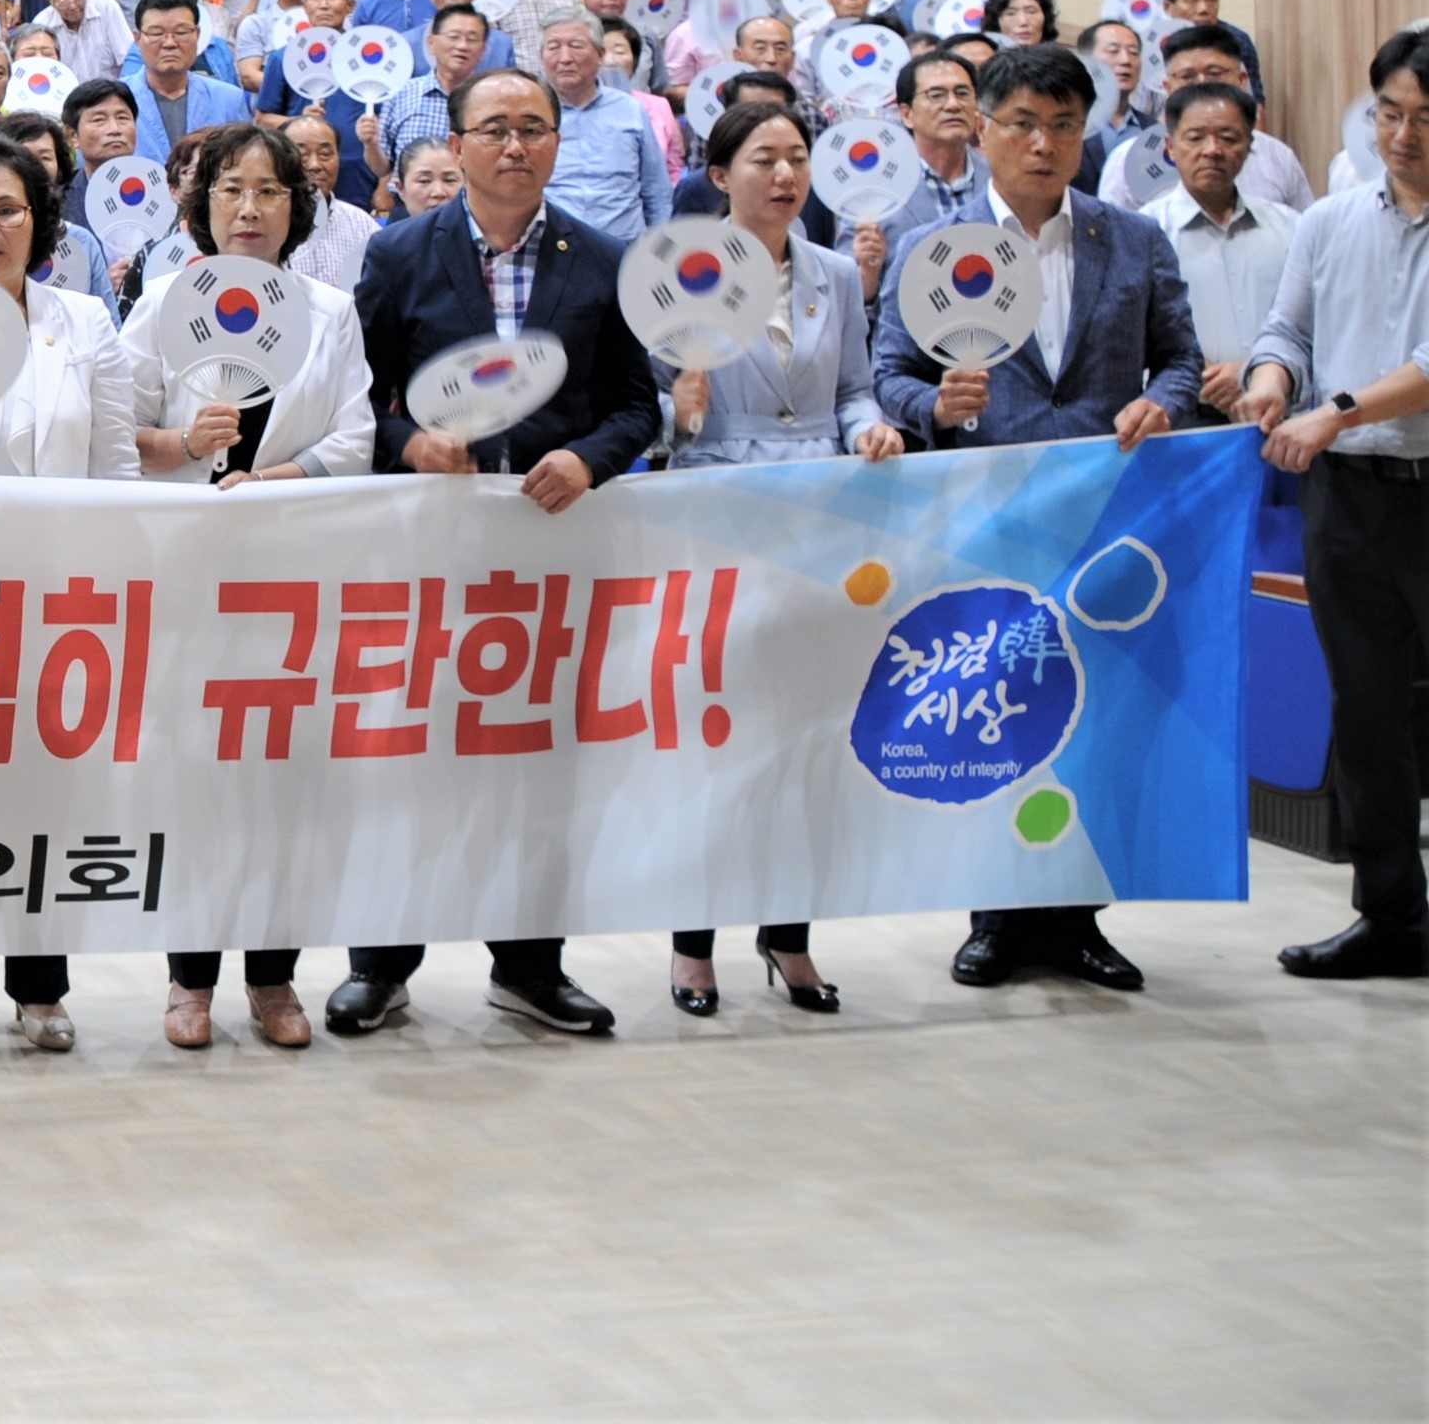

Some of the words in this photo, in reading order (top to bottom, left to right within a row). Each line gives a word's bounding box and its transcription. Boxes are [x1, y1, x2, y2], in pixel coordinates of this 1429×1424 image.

[203, 567, 739, 762] 규탄한다!
[903, 679, 1028, 745] 세상
[880, 742, 928, 760] Korea,
[881, 767, 891, 779] a
[893, 762, 948, 782] country
[950, 760, 966, 778] of
[968, 759, 1023, 780] integrity
